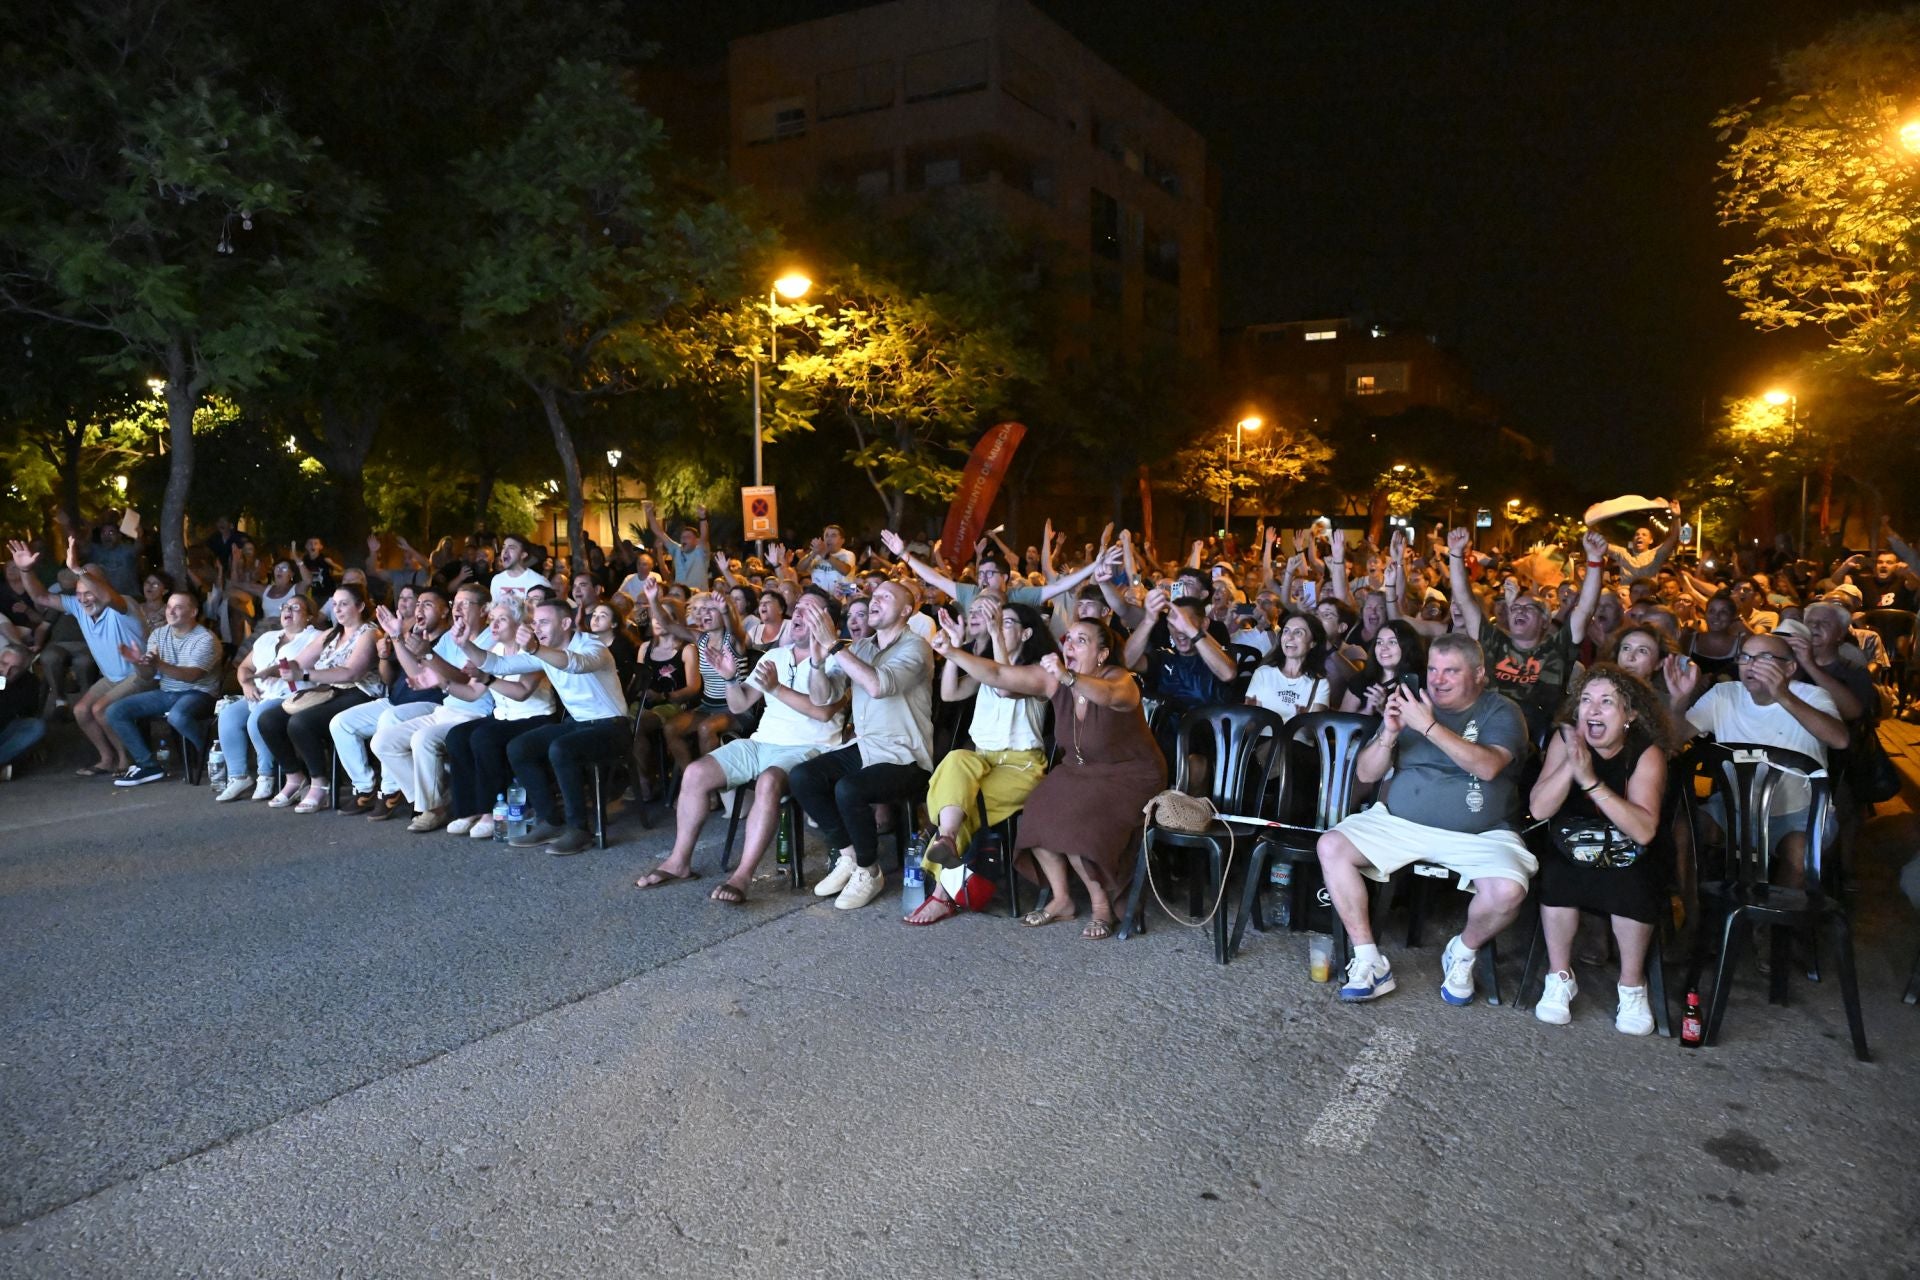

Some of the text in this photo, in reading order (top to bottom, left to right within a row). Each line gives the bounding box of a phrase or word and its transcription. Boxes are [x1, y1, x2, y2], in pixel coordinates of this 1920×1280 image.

[953, 424, 1012, 553] AYUNTAMIENTO DE MURCIA
[1277, 690, 1300, 699] TOMMY
